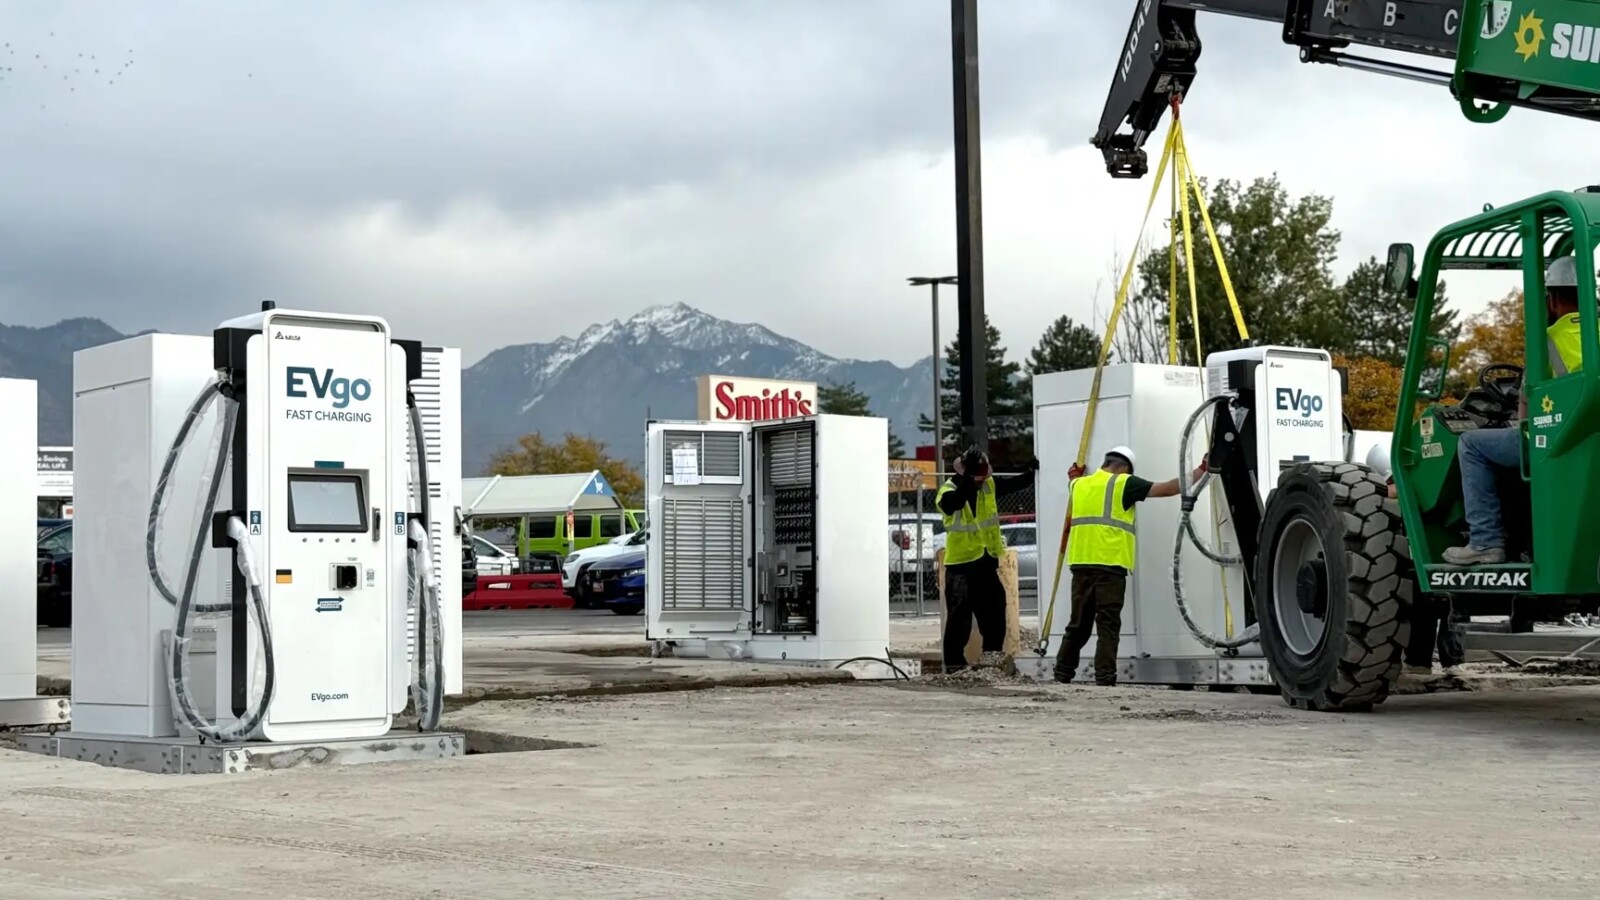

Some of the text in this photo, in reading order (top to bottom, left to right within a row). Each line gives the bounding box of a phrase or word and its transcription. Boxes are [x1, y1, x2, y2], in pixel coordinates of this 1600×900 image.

[1323, 0, 1335, 19] A
[1383, 2, 1397, 28] B
[1444, 9, 1459, 36] C
[1118, 0, 1152, 83] 10042
[286, 366, 372, 409] EVgo
[715, 381, 812, 420] Smith's
[1276, 387, 1323, 418] EVgo
[286, 409, 372, 423] FAST CHARGING
[1276, 418, 1324, 428] FAST CHARGING
[1533, 413, 1562, 426] SUNBLT
[252, 524, 259, 533] A
[396, 525, 404, 534] B
[1430, 572, 1529, 587] SKYTRAK
[311, 692, 349, 703] EVgo.com
